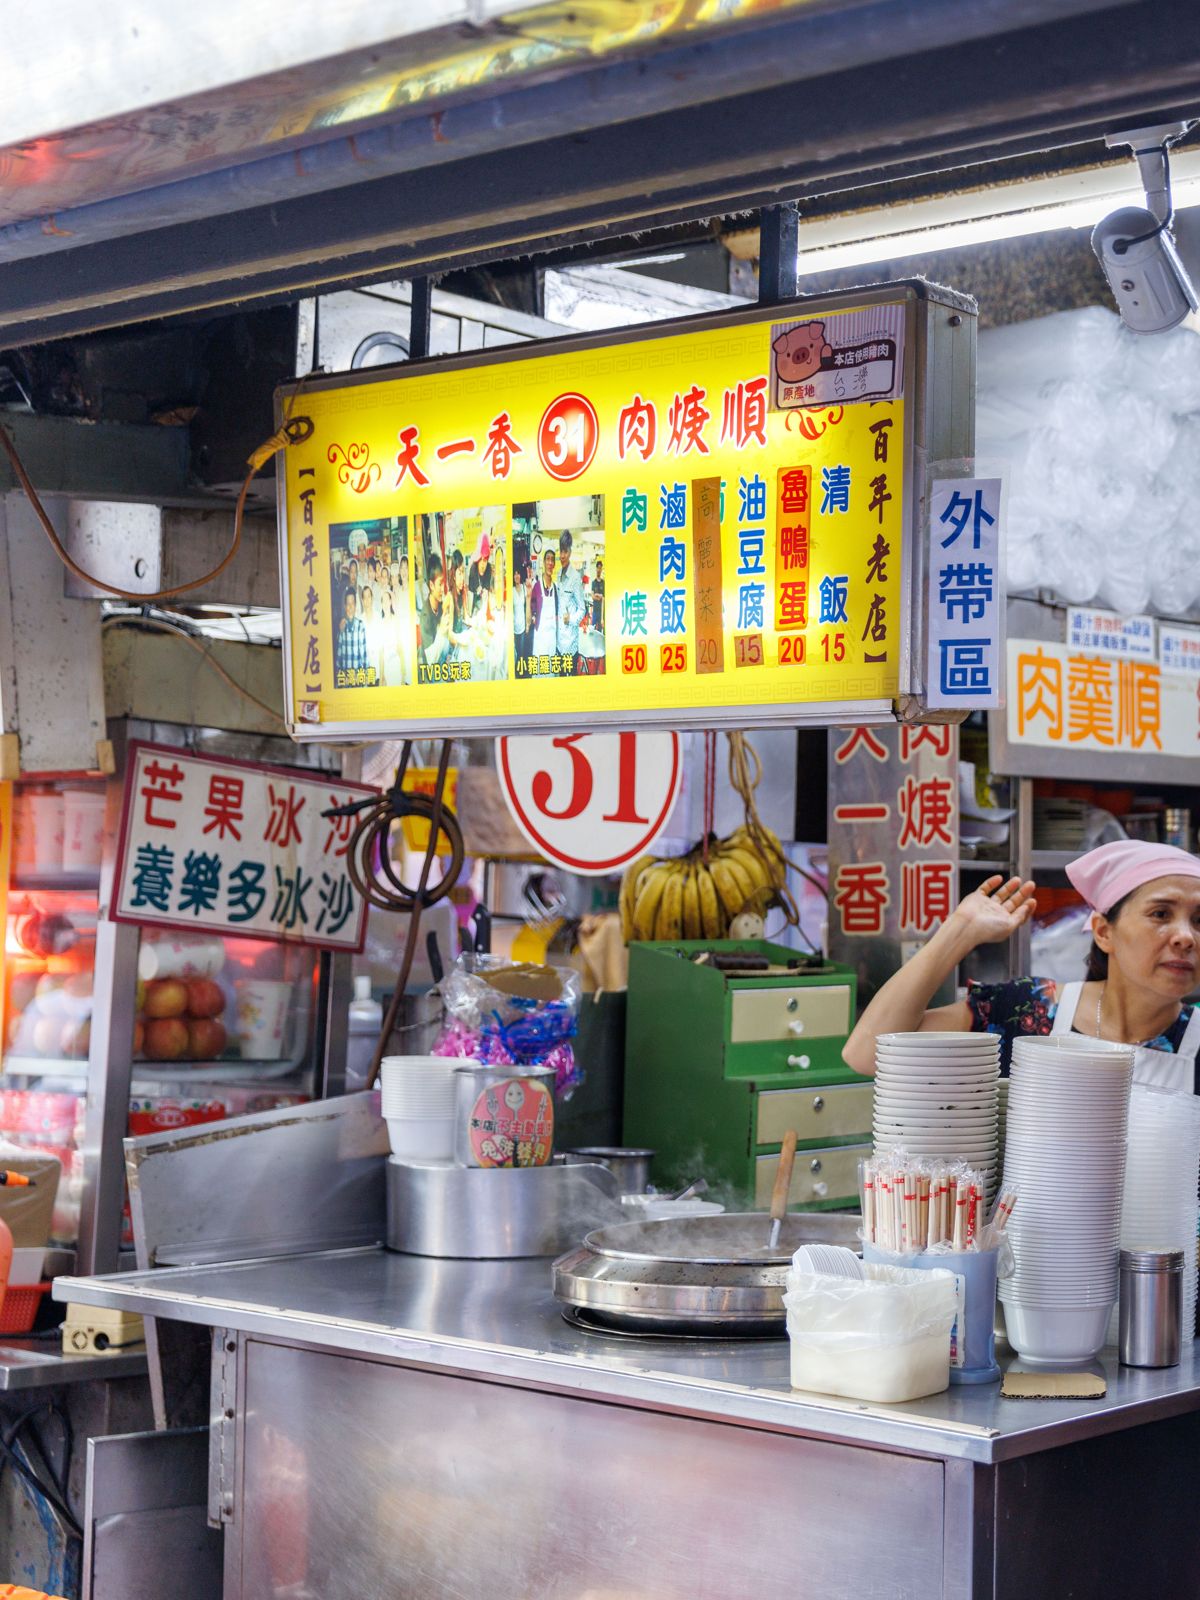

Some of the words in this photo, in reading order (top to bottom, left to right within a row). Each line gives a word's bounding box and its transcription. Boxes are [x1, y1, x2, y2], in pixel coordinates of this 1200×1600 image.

[833, 344, 890, 367] 本店使用豬肉
[783, 383, 815, 400] 原產地
[395, 412, 522, 488] 天一香
[659, 482, 688, 635] 滷肉飯
[737, 474, 767, 630] 油豆腐
[779, 469, 809, 626] 魯鴨蛋
[819, 465, 851, 624] 清飯
[939, 490, 996, 696] 外帶區
[419, 661, 472, 682] TVBS玩家
[517, 654, 574, 676] 小豬羅志祥
[622, 646, 646, 672] 50
[661, 646, 686, 671] 25
[700, 638, 718, 665] 20
[739, 634, 761, 664] 15
[780, 636, 805, 663] 20
[821, 633, 846, 662] 15
[1017, 645, 1163, 751] 肉羹順
[532, 732, 650, 825] 31
[141, 760, 361, 857] 芒果冰沙
[130, 842, 355, 935] 養樂多冰沙
